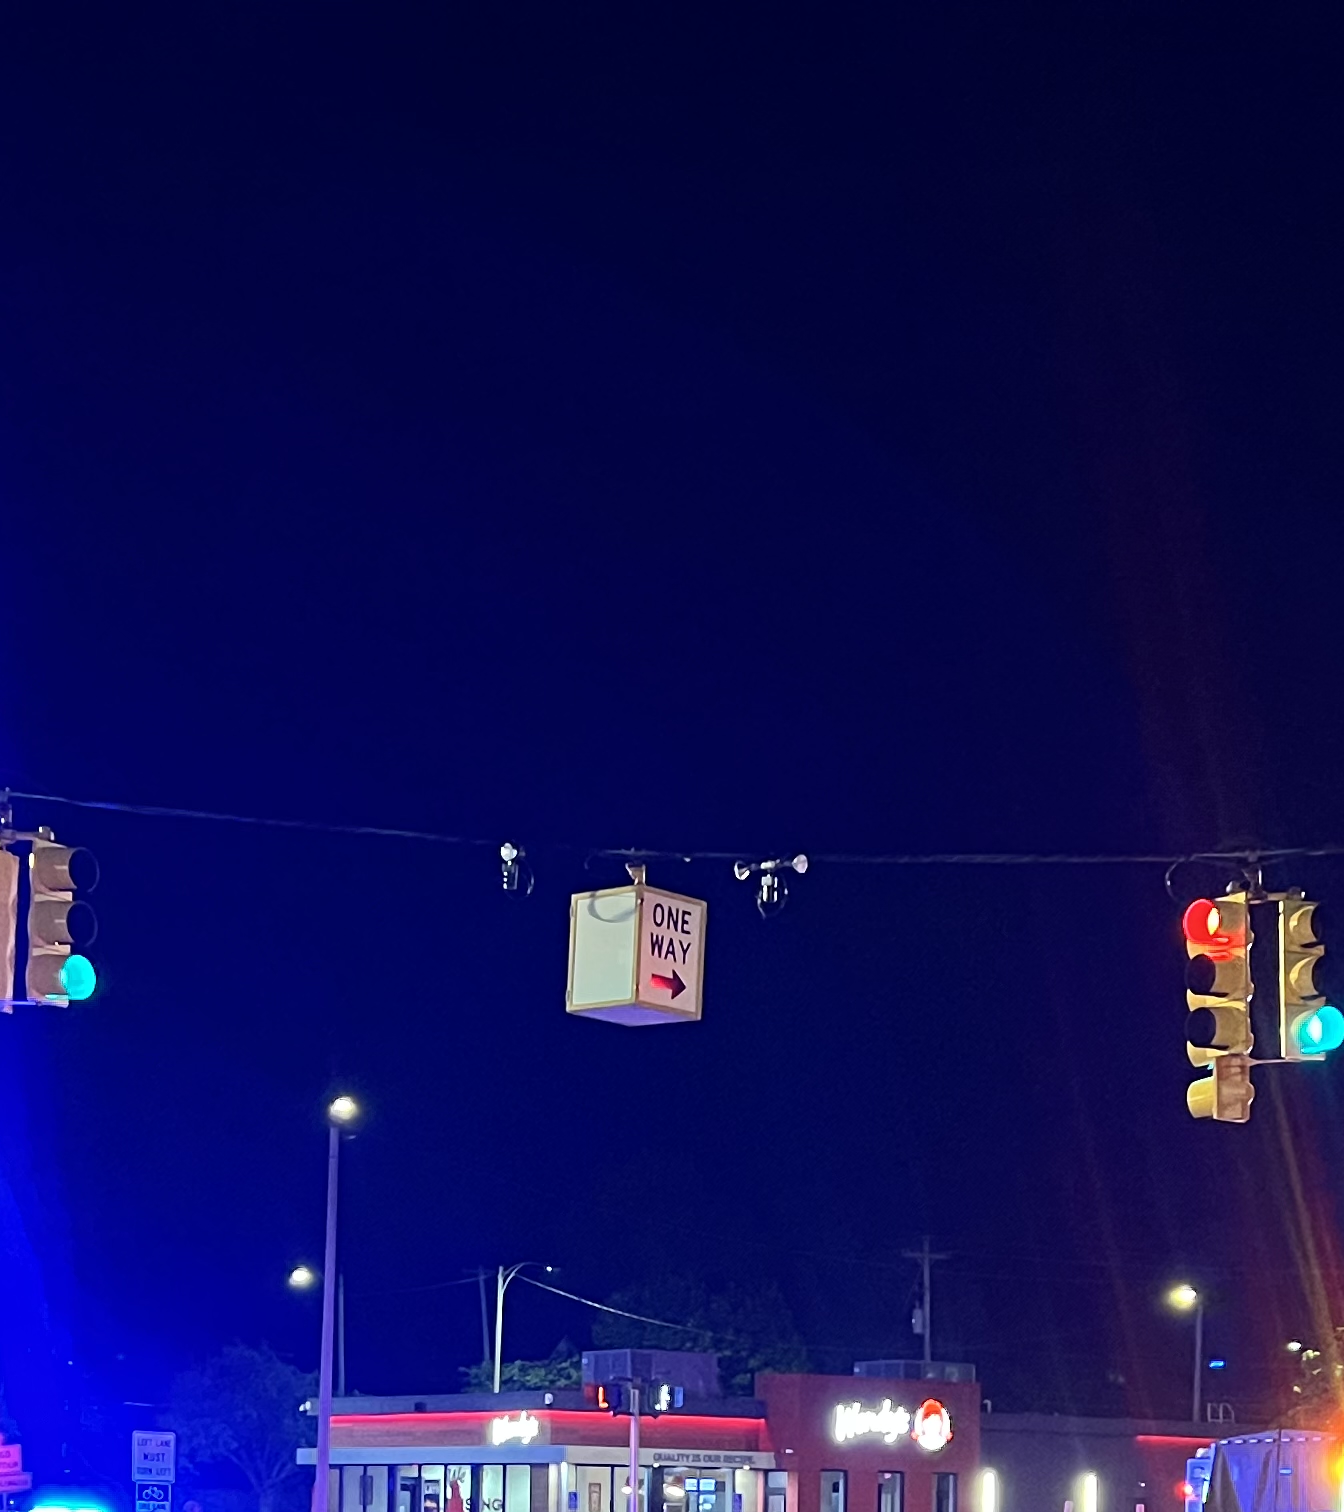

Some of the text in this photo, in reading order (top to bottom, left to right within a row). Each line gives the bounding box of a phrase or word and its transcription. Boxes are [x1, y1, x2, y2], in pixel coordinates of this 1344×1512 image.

[652, 903, 692, 935] ONE
[650, 932, 692, 964] WAY
[143, 1452, 166, 1463] MUST
[653, 1453, 692, 1463] QUALITY
[692, 1454, 702, 1463] IS
[703, 1454, 722, 1463] OUR
